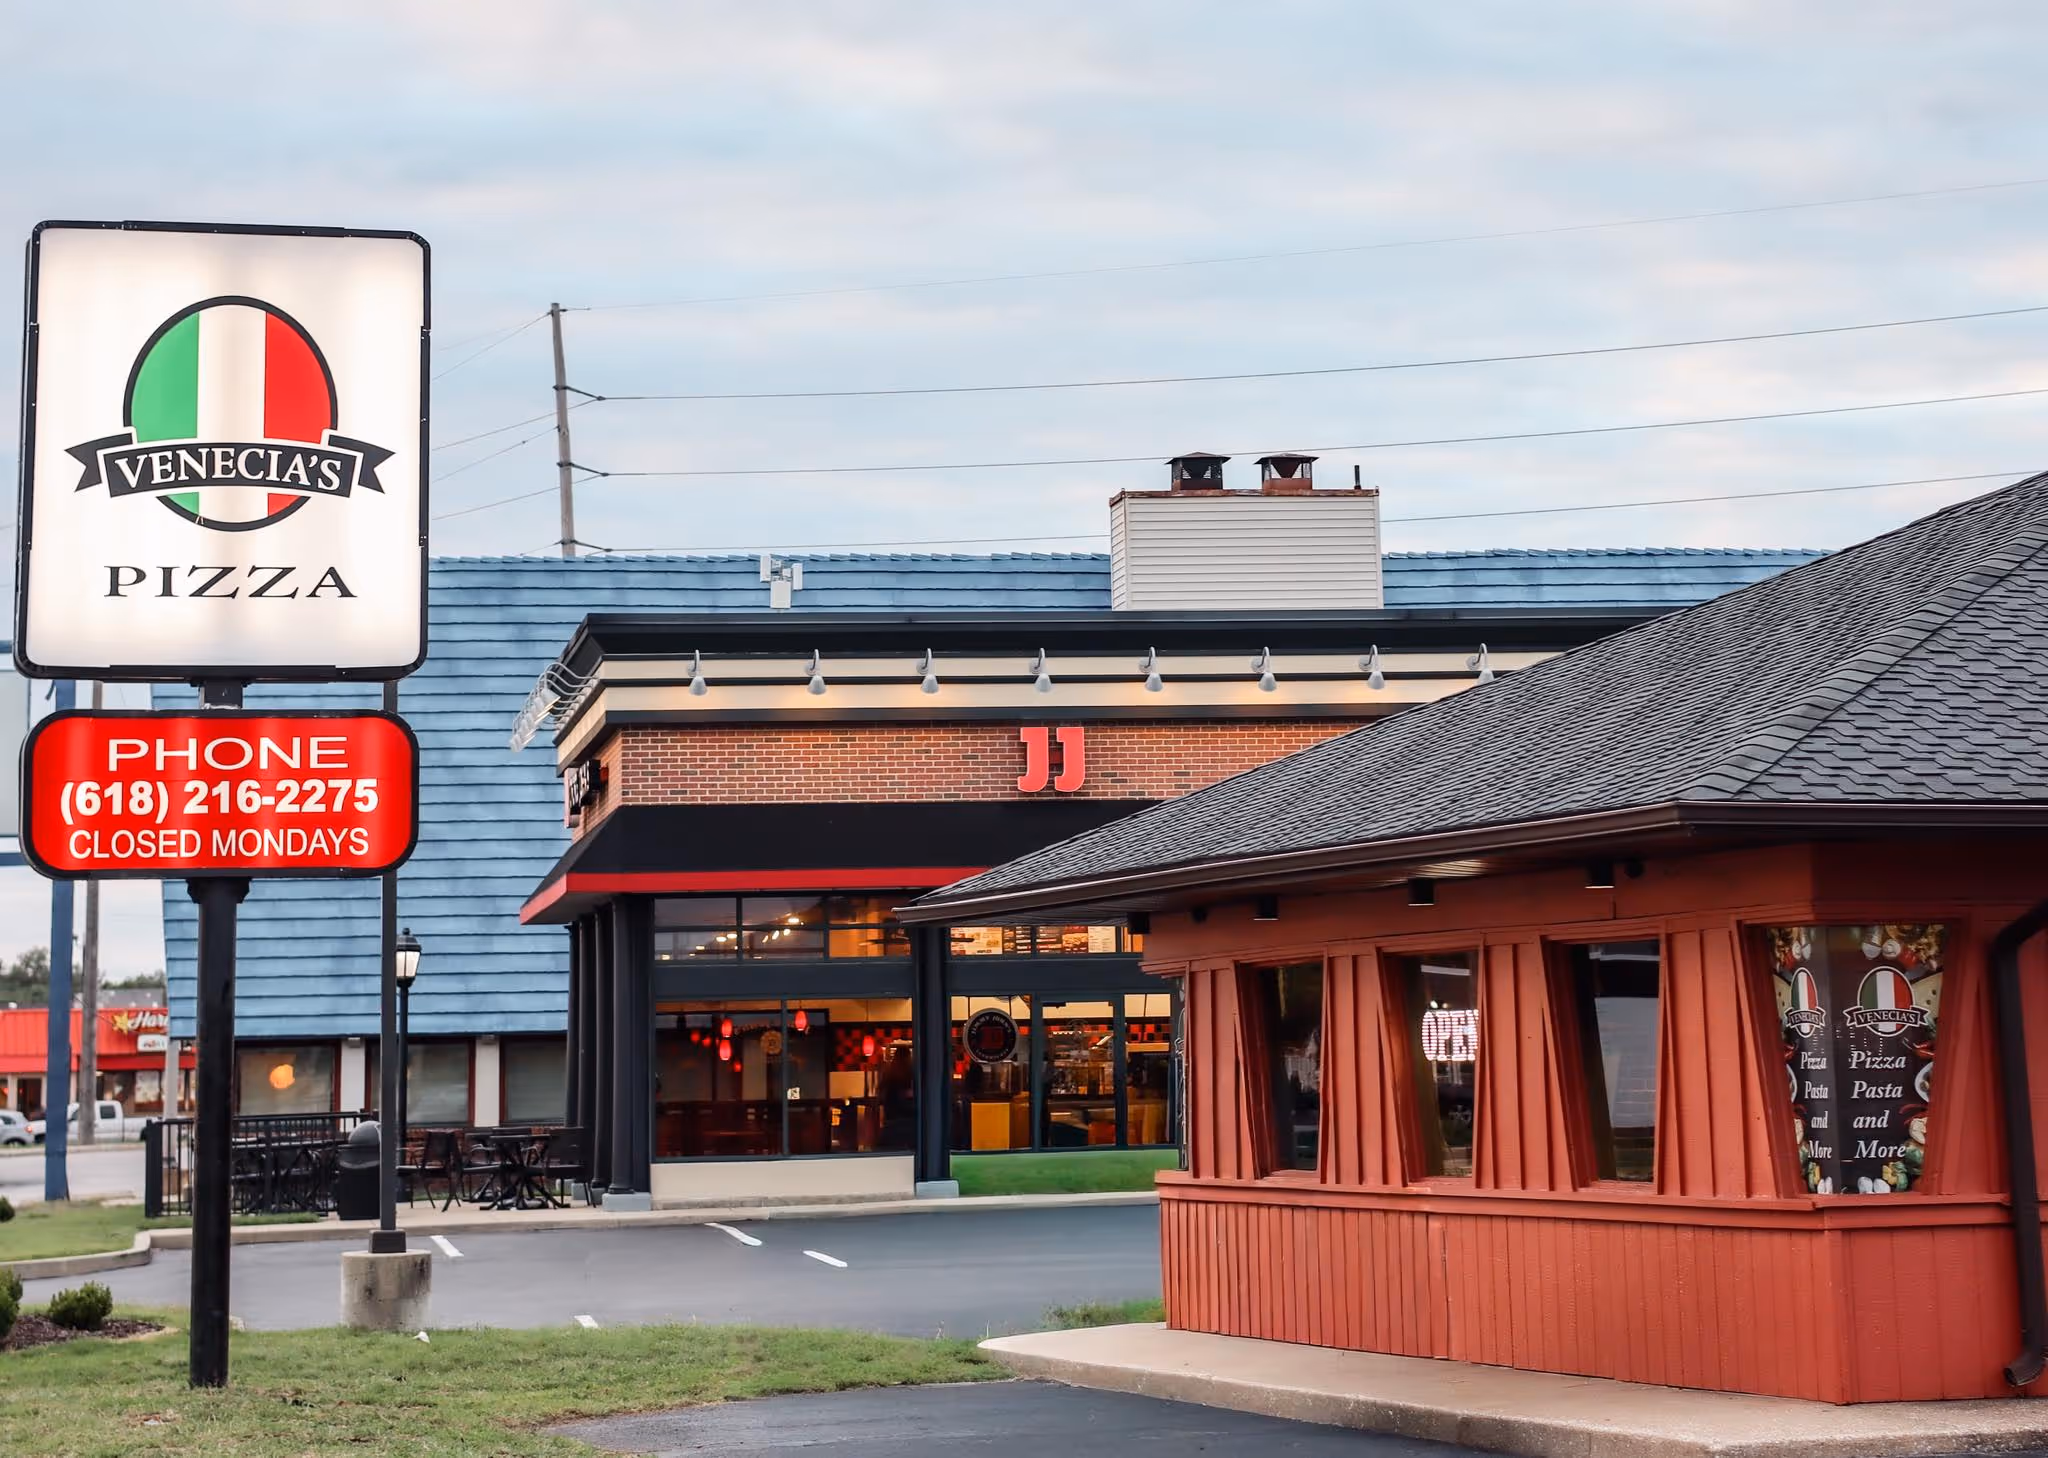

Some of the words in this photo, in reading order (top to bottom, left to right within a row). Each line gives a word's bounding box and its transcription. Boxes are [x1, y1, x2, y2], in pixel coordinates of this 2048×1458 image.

[115, 447, 343, 491] VENECIA'S
[103, 565, 358, 598] PIZZA
[109, 737, 348, 771] PHONE
[1017, 727, 1085, 792] JJ
[60, 780, 168, 824] (618)
[184, 779, 379, 814] 216-2275
[69, 829, 202, 859] CLOSED
[211, 827, 369, 857] MONDAYS
[1858, 1011, 1915, 1024] VENECIA'S
[1800, 1052, 1828, 1070] Pizza
[1851, 1051, 1906, 1069] Pizza
[1804, 1081, 1828, 1099] Pasta
[1851, 1081, 1904, 1099] Pasta
[1811, 1110, 1828, 1129] and
[1853, 1109, 1890, 1129] and
[1808, 1140, 1833, 1160] More
[1854, 1140, 1906, 1159] More
